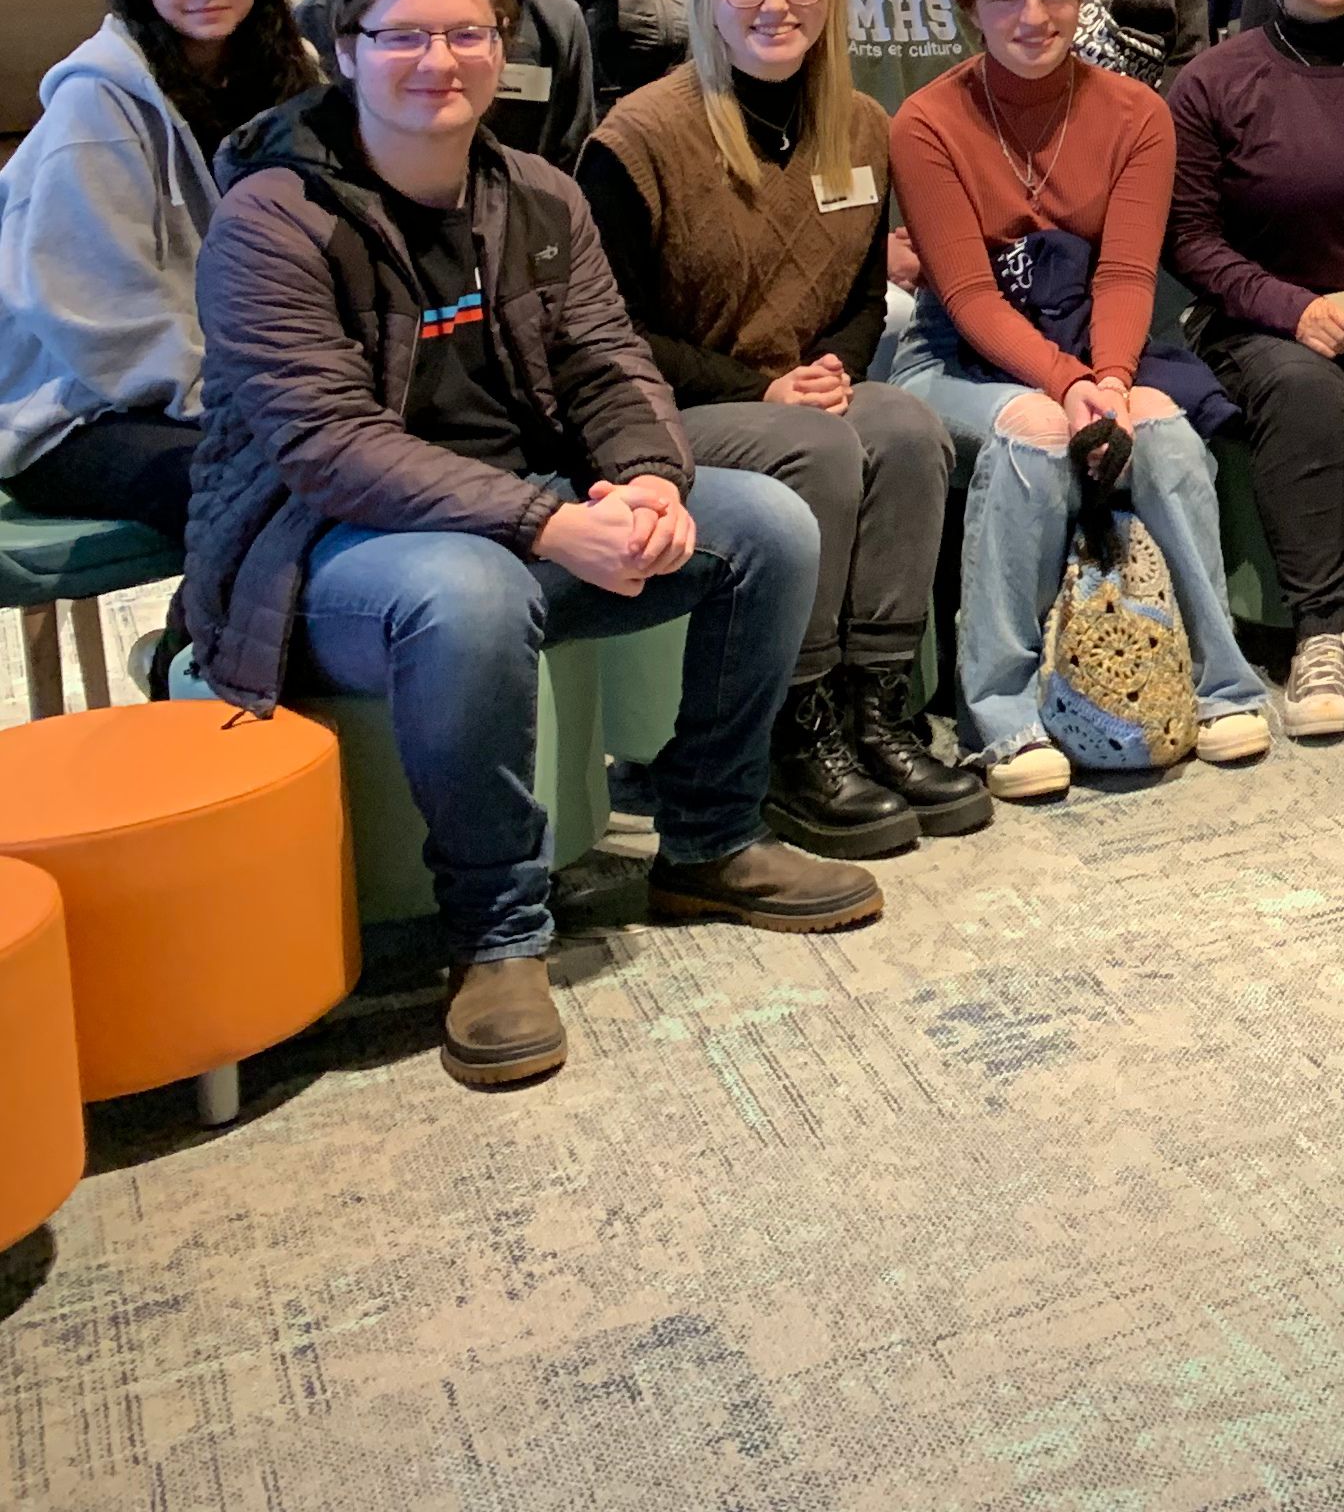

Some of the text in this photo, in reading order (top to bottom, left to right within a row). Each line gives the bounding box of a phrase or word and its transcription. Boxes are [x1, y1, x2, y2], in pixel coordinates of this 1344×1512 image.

[848, 39, 962, 58] Arts et culture
